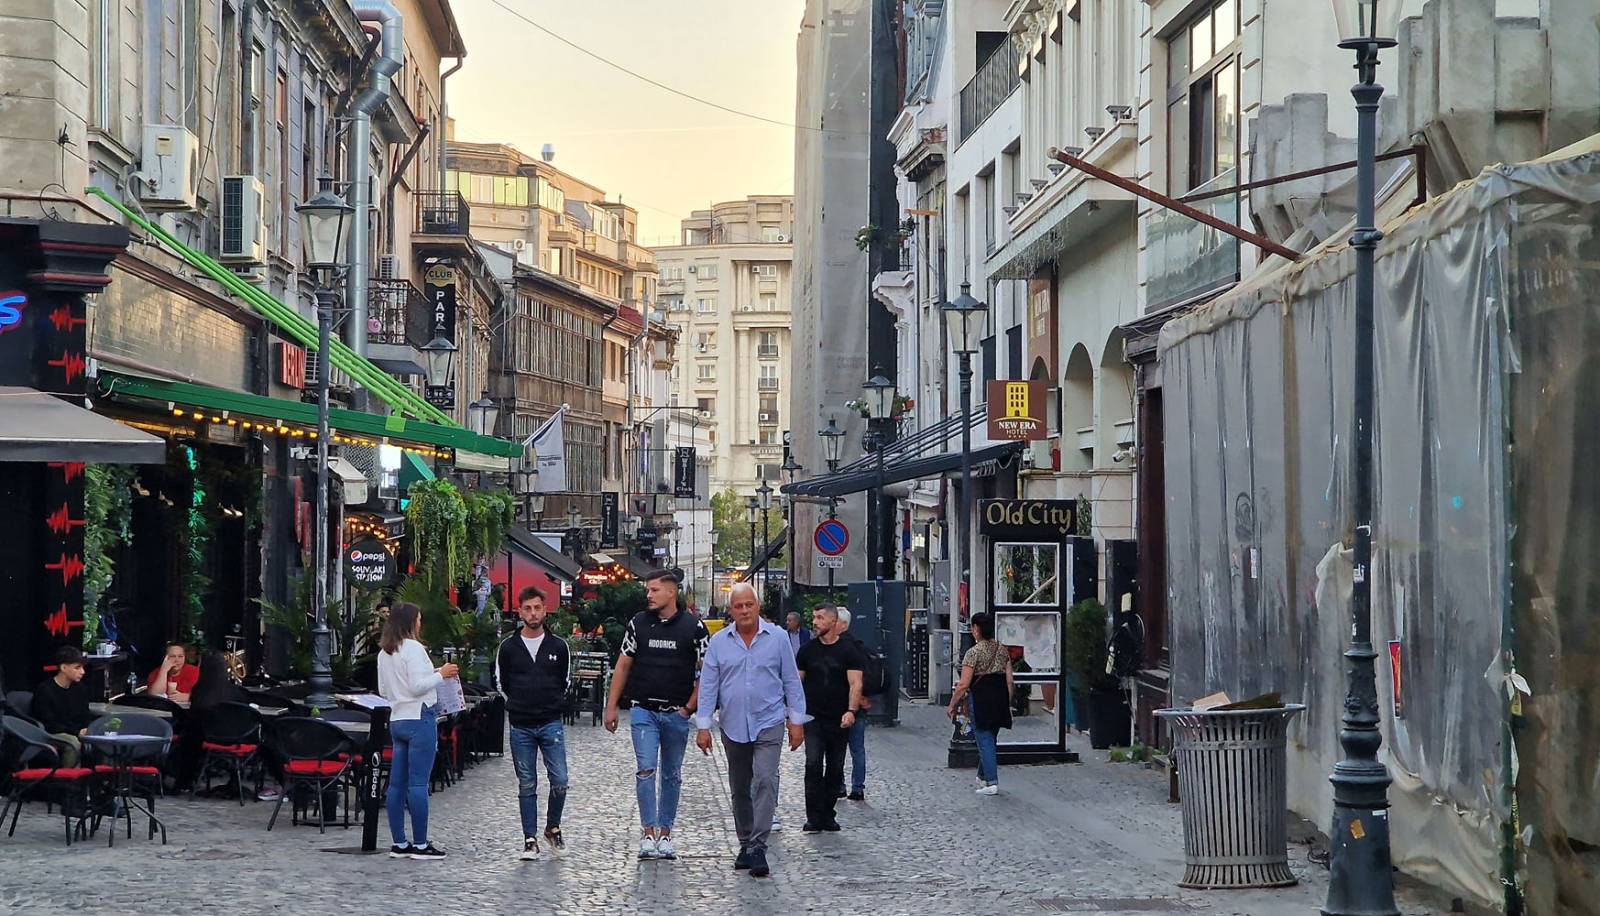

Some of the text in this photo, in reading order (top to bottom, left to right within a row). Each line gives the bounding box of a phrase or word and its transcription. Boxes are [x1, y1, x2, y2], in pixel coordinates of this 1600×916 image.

[428, 271, 453, 279] CLUB
[998, 421, 1037, 430] NEW ERA
[986, 501, 1072, 534] Old City
[362, 552, 386, 562] pepsi
[351, 565, 386, 575] SOUVAKI
[370, 768, 380, 798] pepsi
